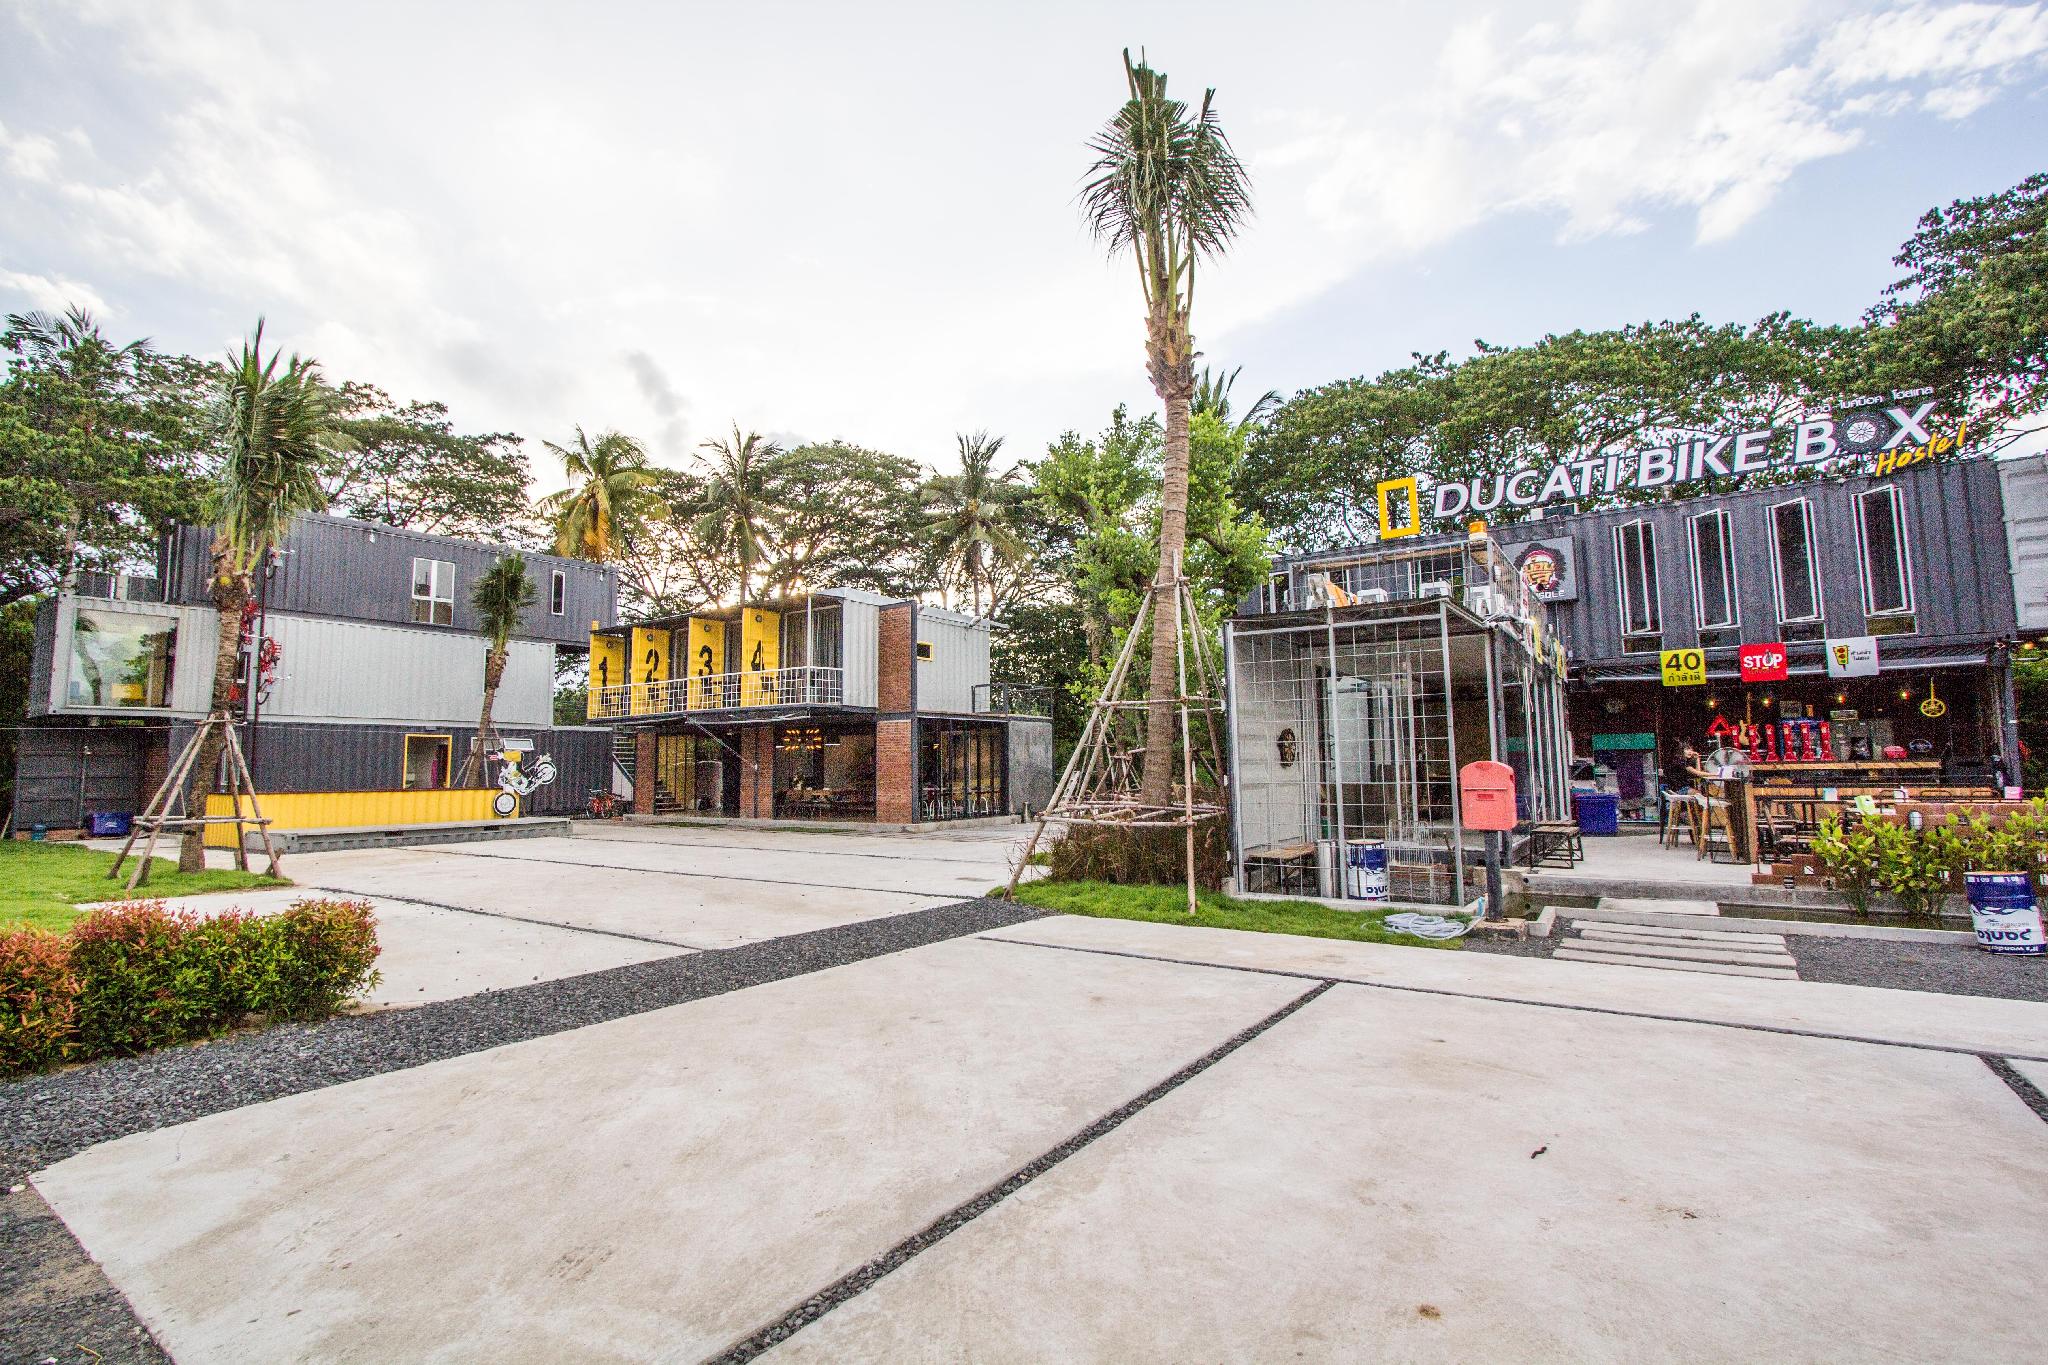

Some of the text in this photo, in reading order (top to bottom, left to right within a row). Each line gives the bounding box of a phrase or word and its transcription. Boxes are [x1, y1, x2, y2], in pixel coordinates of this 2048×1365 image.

[1433, 401, 1938, 518] DUCATI BIKE BOX
[1876, 421, 1967, 478] Hostel
[599, 656, 608, 689] 1
[645, 649, 660, 685] 2
[699, 645, 713, 681] 3
[751, 640, 765, 673] 4
[1665, 652, 1701, 671] 40
[1743, 653, 1783, 668] STOP
